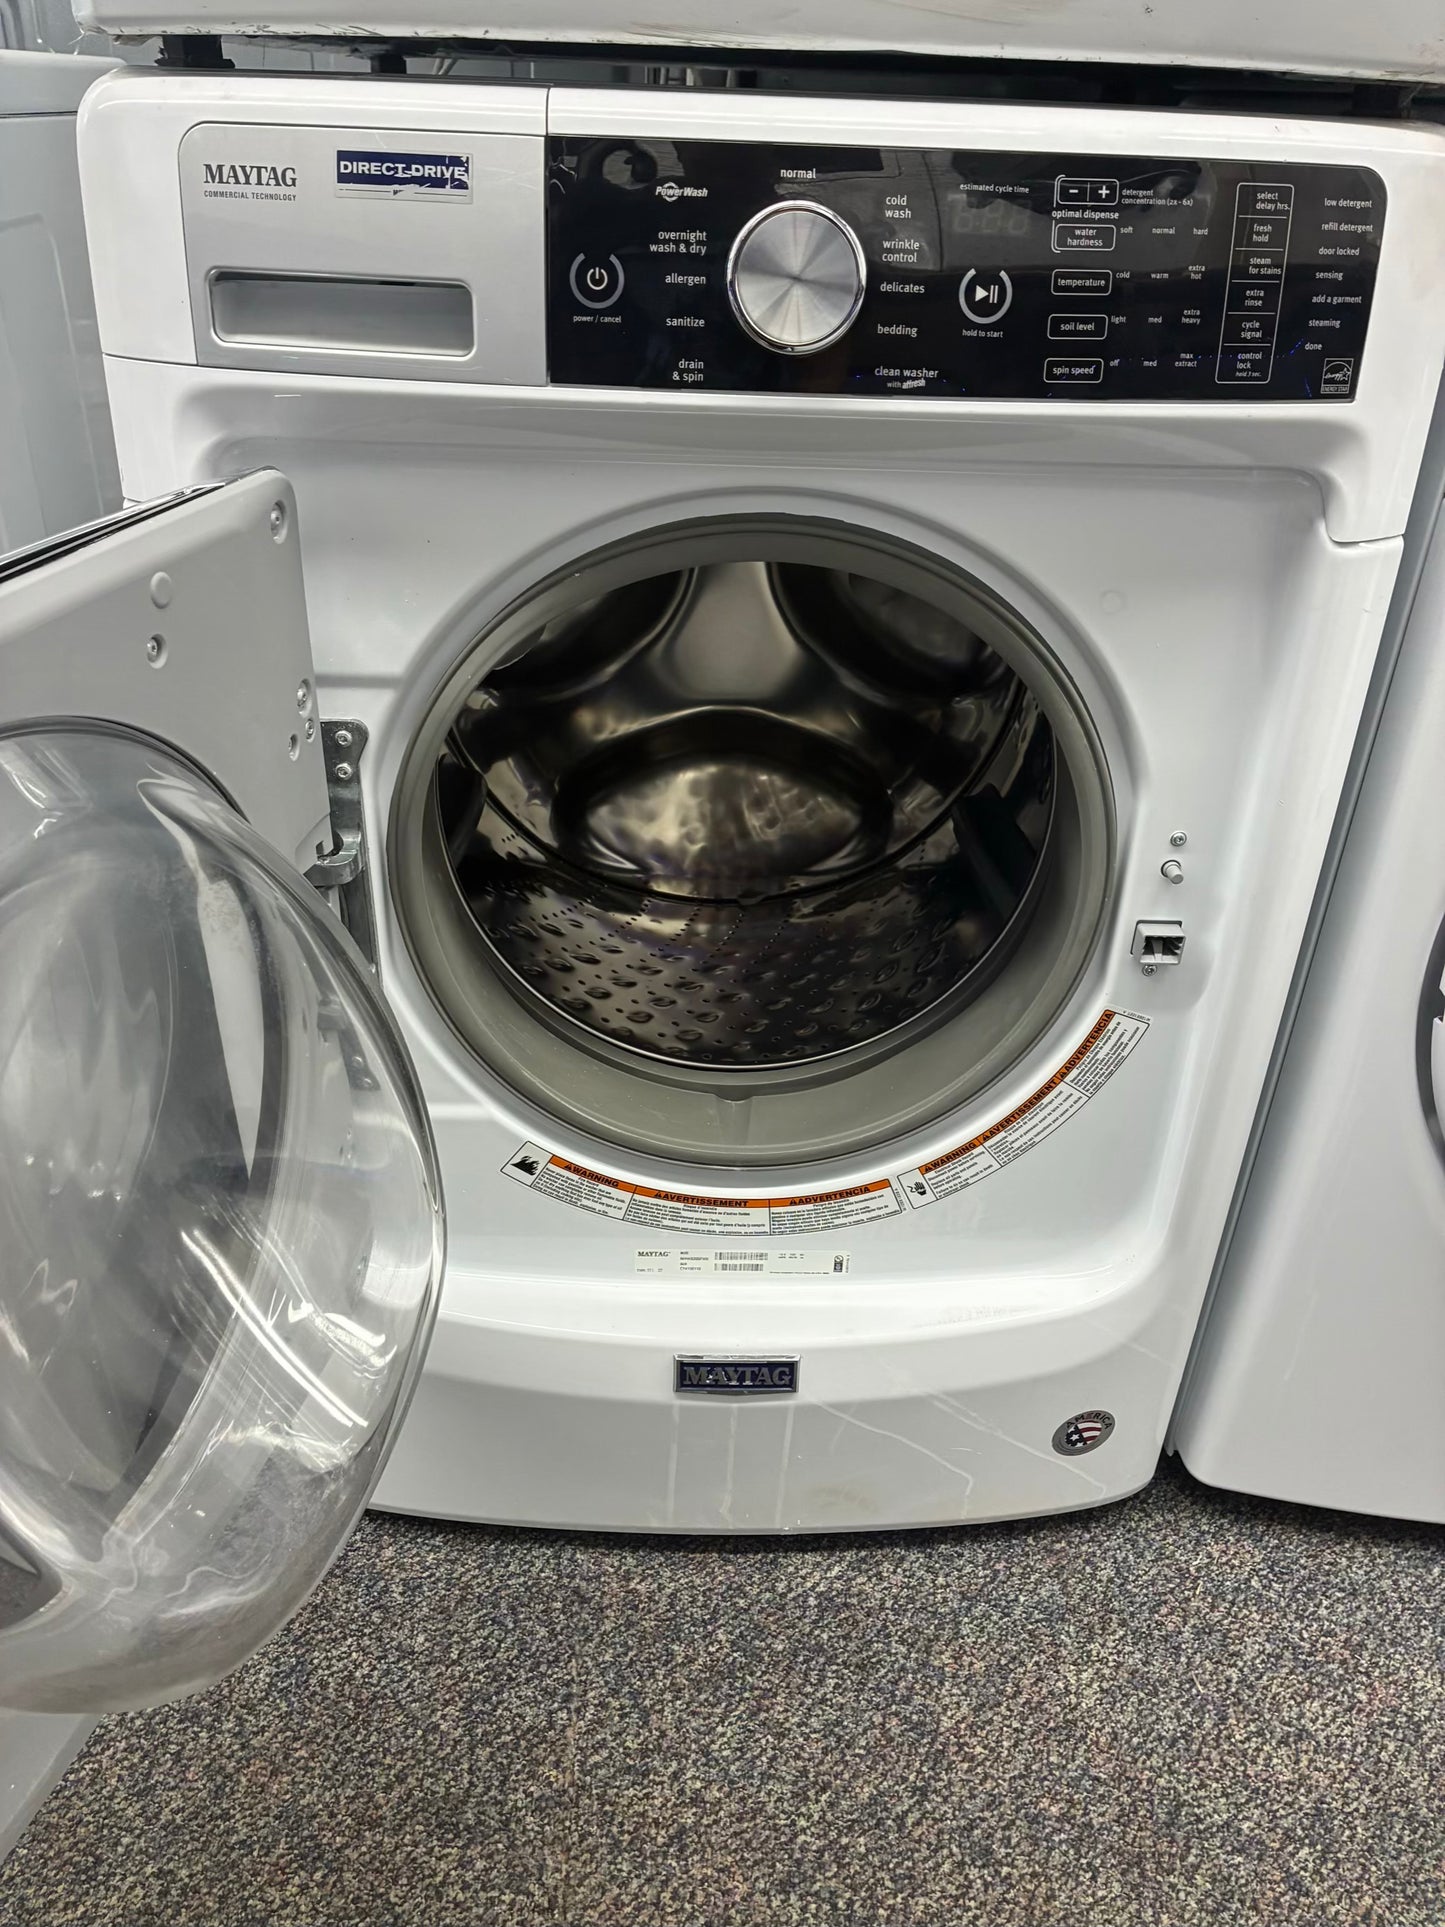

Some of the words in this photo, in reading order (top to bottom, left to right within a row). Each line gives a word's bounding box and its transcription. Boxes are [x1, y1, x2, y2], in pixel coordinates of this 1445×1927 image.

[203, 163, 298, 187] MAYTAG
[339, 160, 406, 176] DIRECT
[411, 164, 468, 180] DRIVE
[780, 167, 816, 179] normal
[959, 183, 994, 191] estimated
[995, 184, 1013, 194] cycle
[1121, 188, 1154, 197] detergent
[204, 190, 249, 199] COMMERCIAL
[251, 192, 297, 202] TECHNOLOGY
[886, 195, 907, 206] cold
[1256, 191, 1279, 200] select
[1167, 198, 1178, 206] (2x
[1256, 202, 1276, 211] delay
[1277, 202, 1291, 210] hrs.
[1324, 198, 1339, 206] low
[1339, 199, 1372, 209] detergent
[885, 208, 912, 219] wash
[1052, 209, 1082, 220] optimal
[1083, 210, 1119, 220] dispense
[1075, 228, 1097, 236] water
[1120, 226, 1133, 234] soft
[1152, 227, 1175, 235] normal
[1193, 227, 1208, 235] hard
[1253, 224, 1272, 233] fresh
[1322, 222, 1338, 231] refill
[1339, 223, 1374, 233] detergent
[658, 230, 707, 242] overnight
[1253, 234, 1269, 242] hold
[882, 239, 920, 250] wrinkle
[1067, 238, 1103, 246] hardness
[650, 243, 676, 253] wash
[679, 243, 687, 253] &
[689, 243, 707, 256] dry
[1319, 247, 1335, 256] door
[1336, 247, 1360, 256] locked
[882, 252, 917, 263] control
[1250, 257, 1271, 265] steam
[1116, 271, 1130, 279] cold
[1249, 266, 1259, 274] for
[1260, 267, 1282, 275] stains
[665, 273, 707, 287] allergen
[1191, 272, 1202, 280] hot
[1316, 271, 1343, 281] sensing
[880, 282, 925, 294] delicates
[1058, 278, 1105, 288] temperature
[1246, 289, 1264, 297] extra
[1245, 299, 1263, 307] rinse
[1312, 294, 1326, 303] add
[1332, 295, 1362, 305] garment
[573, 315, 594, 324] power
[600, 315, 622, 324] cancel
[666, 316, 705, 328] sanitize
[1111, 315, 1126, 324] light
[1148, 316, 1162, 324] med
[1182, 316, 1201, 325] heavy
[1242, 320, 1260, 329] cycle
[1308, 318, 1341, 328] steaming
[877, 324, 918, 337] bedding
[1060, 322, 1075, 331] soil
[1076, 322, 1095, 331] level
[962, 329, 977, 337] hold
[978, 329, 986, 337] to
[986, 330, 1004, 338] start
[1240, 330, 1263, 339] signal
[1305, 342, 1323, 350] done
[1237, 352, 1262, 360] control
[678, 358, 704, 369] drain
[1109, 359, 1119, 367] off
[1143, 359, 1157, 367] med
[1175, 360, 1197, 368] extract
[1236, 361, 1252, 369] lock
[874, 366, 900, 376] clean
[903, 367, 939, 378] washer
[1053, 366, 1069, 376] spin
[1071, 366, 1094, 376] speed
[672, 371, 680, 381] &
[683, 371, 704, 383] spin
[1065, 1012, 1113, 1072] ADVERTENCIA
[989, 1078, 1058, 1137] AVERTISSEMENT
[931, 1142, 976, 1168] WARNING
[572, 1167, 619, 1188] WARNING
[662, 1193, 749, 1207] AVERTISSEMENT
[795, 1186, 871, 1205] ADVERTENCIA
[682, 1366, 791, 1385] MAYTAG
